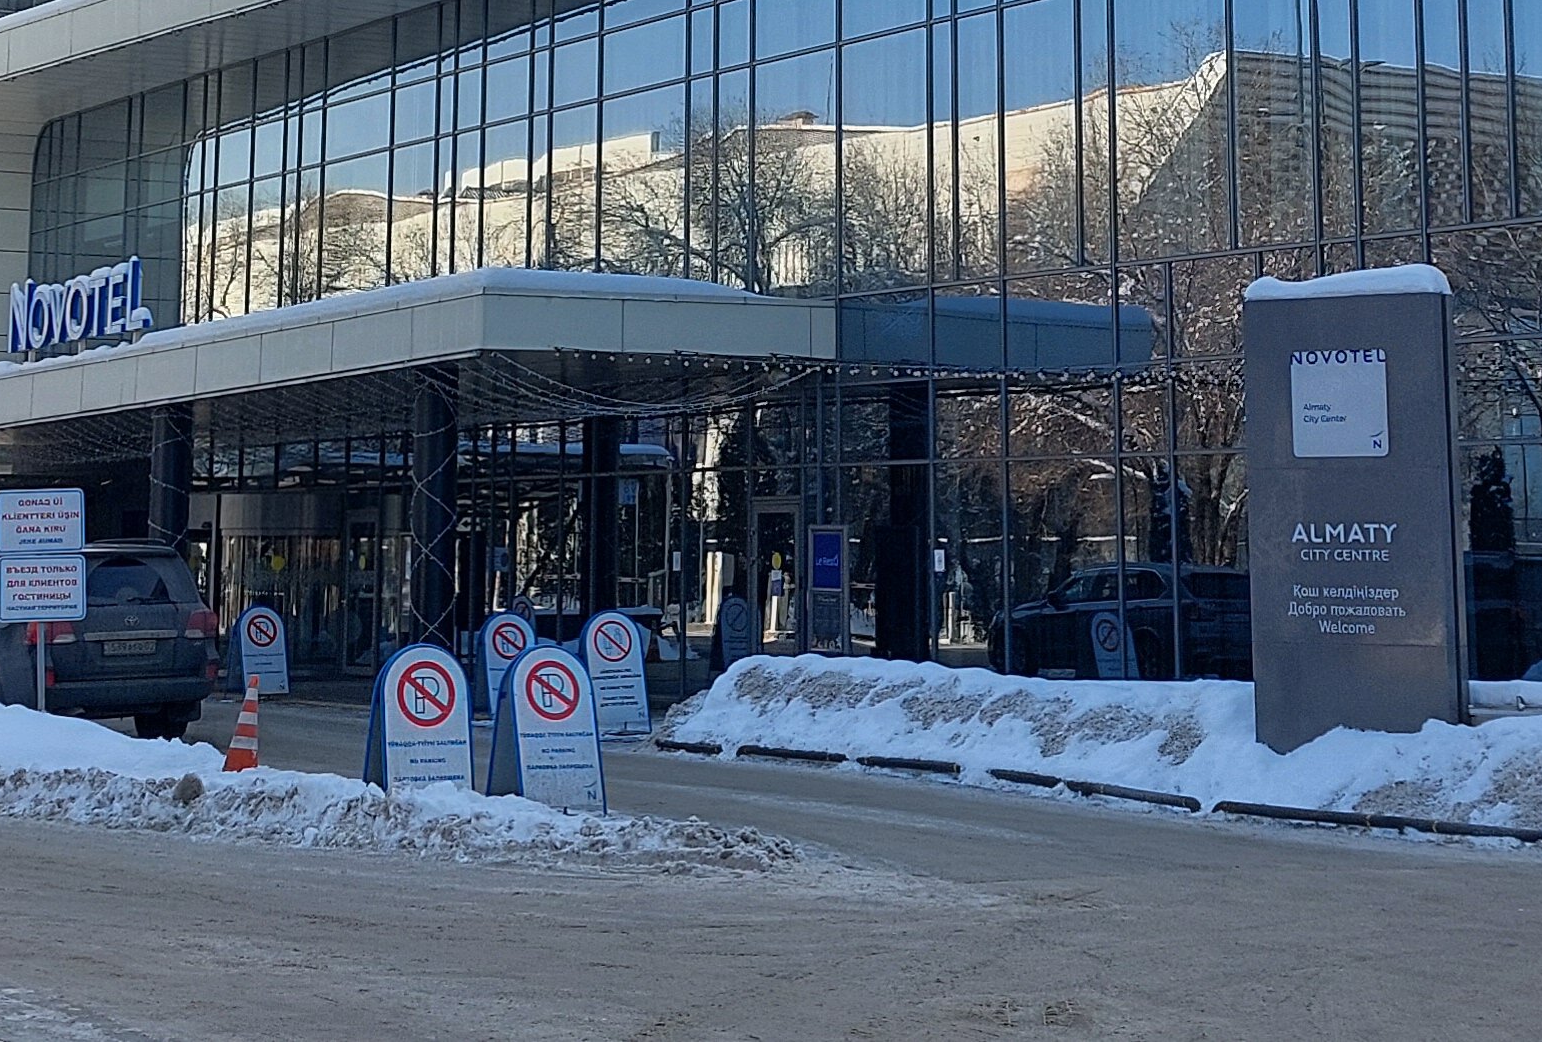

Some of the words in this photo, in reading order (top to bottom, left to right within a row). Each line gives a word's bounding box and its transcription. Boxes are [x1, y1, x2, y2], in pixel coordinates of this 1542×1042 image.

[7, 258, 153, 354] NOVOTEL
[1289, 347, 1388, 366] NOVOTEL
[1303, 403, 1332, 413] Almaty
[1303, 414, 1320, 424] City
[1320, 414, 1347, 423] Center
[1373, 439, 1382, 449] N
[1291, 522, 1397, 544] ALMATY
[1301, 549, 1330, 561] CITY
[1334, 549, 1390, 561] CENTRE
[6, 566, 38, 575] ВЪЕЗД
[41, 565, 78, 574] ТОЛЬКО
[7, 579, 26, 589] ДЛЯ
[28, 579, 78, 587] КЛИЕНТОВ
[12, 592, 72, 601] ГОСТИНИЦЫ
[1293, 584, 1319, 599] Қош
[1323, 585, 1399, 600] келдіңіздер
[1288, 601, 1327, 618] Добро
[1330, 606, 1406, 617] пожаловать
[1319, 620, 1375, 634] Welcome
